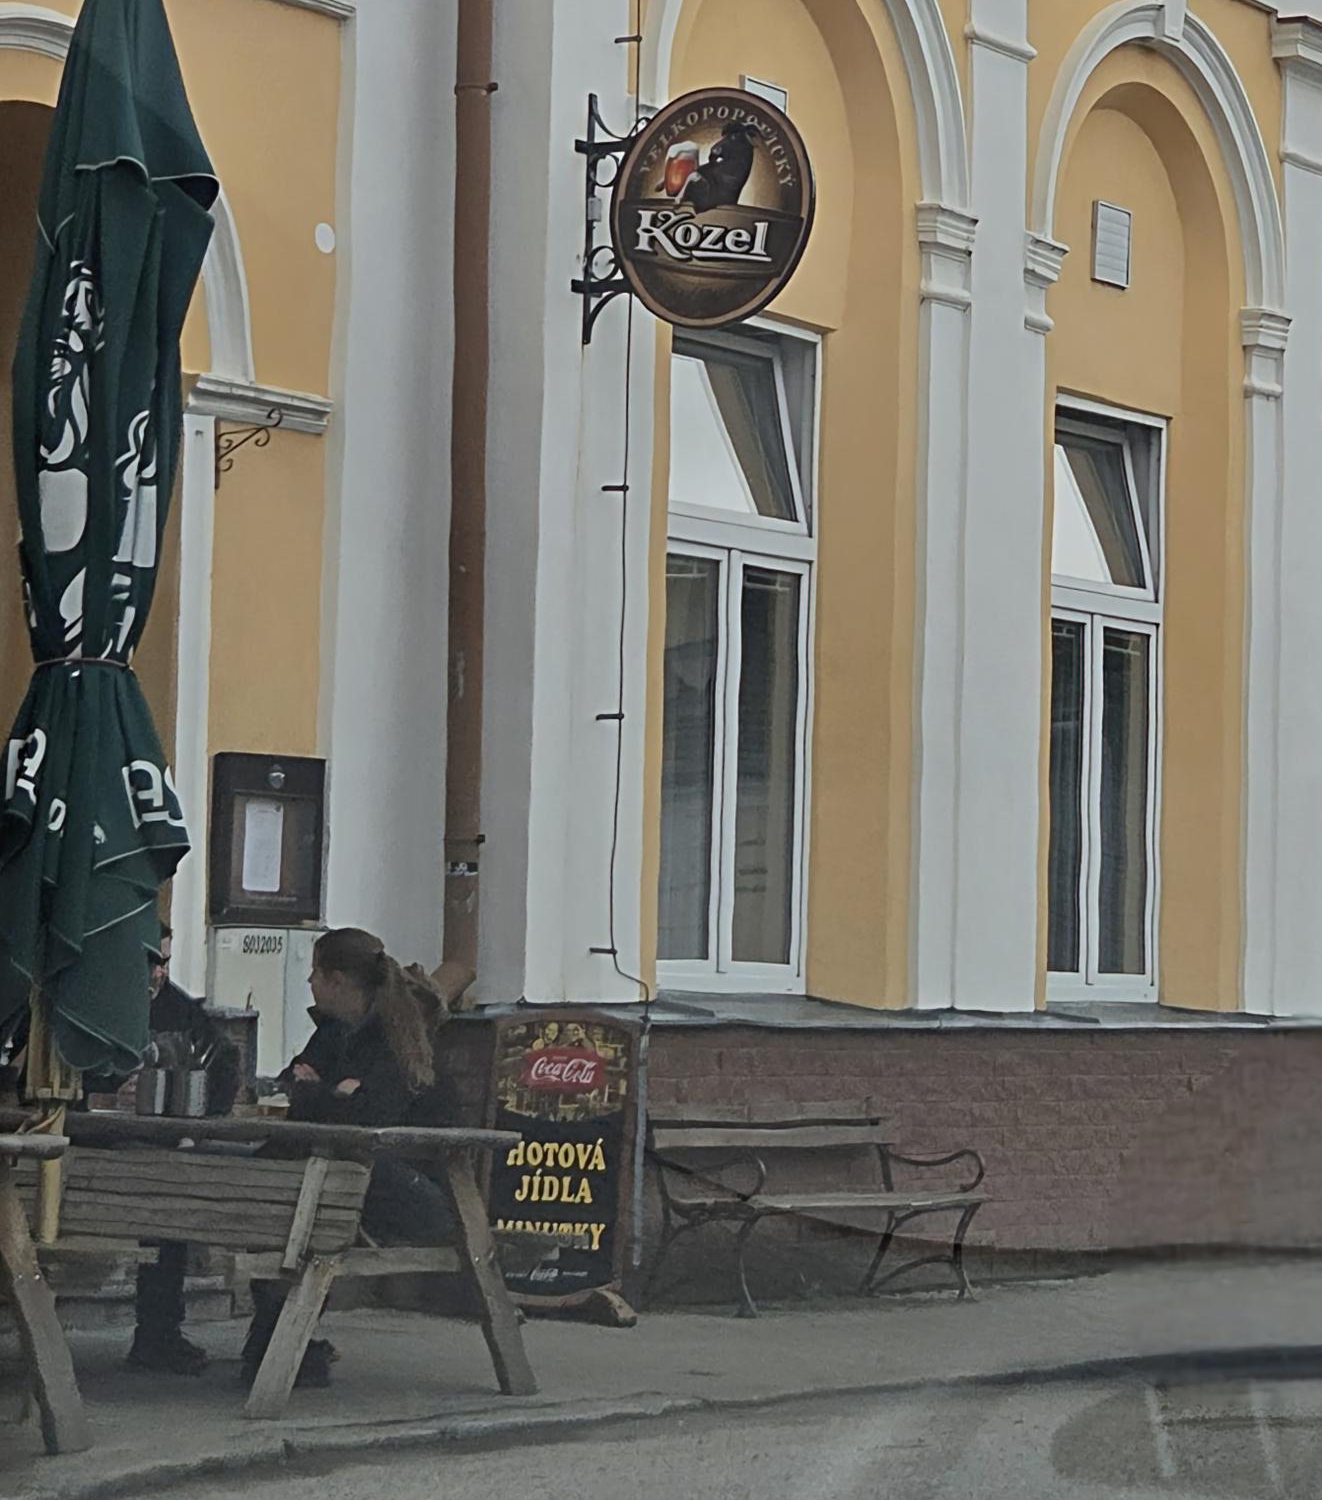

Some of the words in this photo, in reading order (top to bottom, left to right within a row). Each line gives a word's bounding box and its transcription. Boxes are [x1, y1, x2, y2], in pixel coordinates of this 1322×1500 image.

[635, 210, 771, 259] Kozel
[507, 1138, 606, 1170] HOTOVÁ
[515, 1168, 593, 1204] JÍDLA
